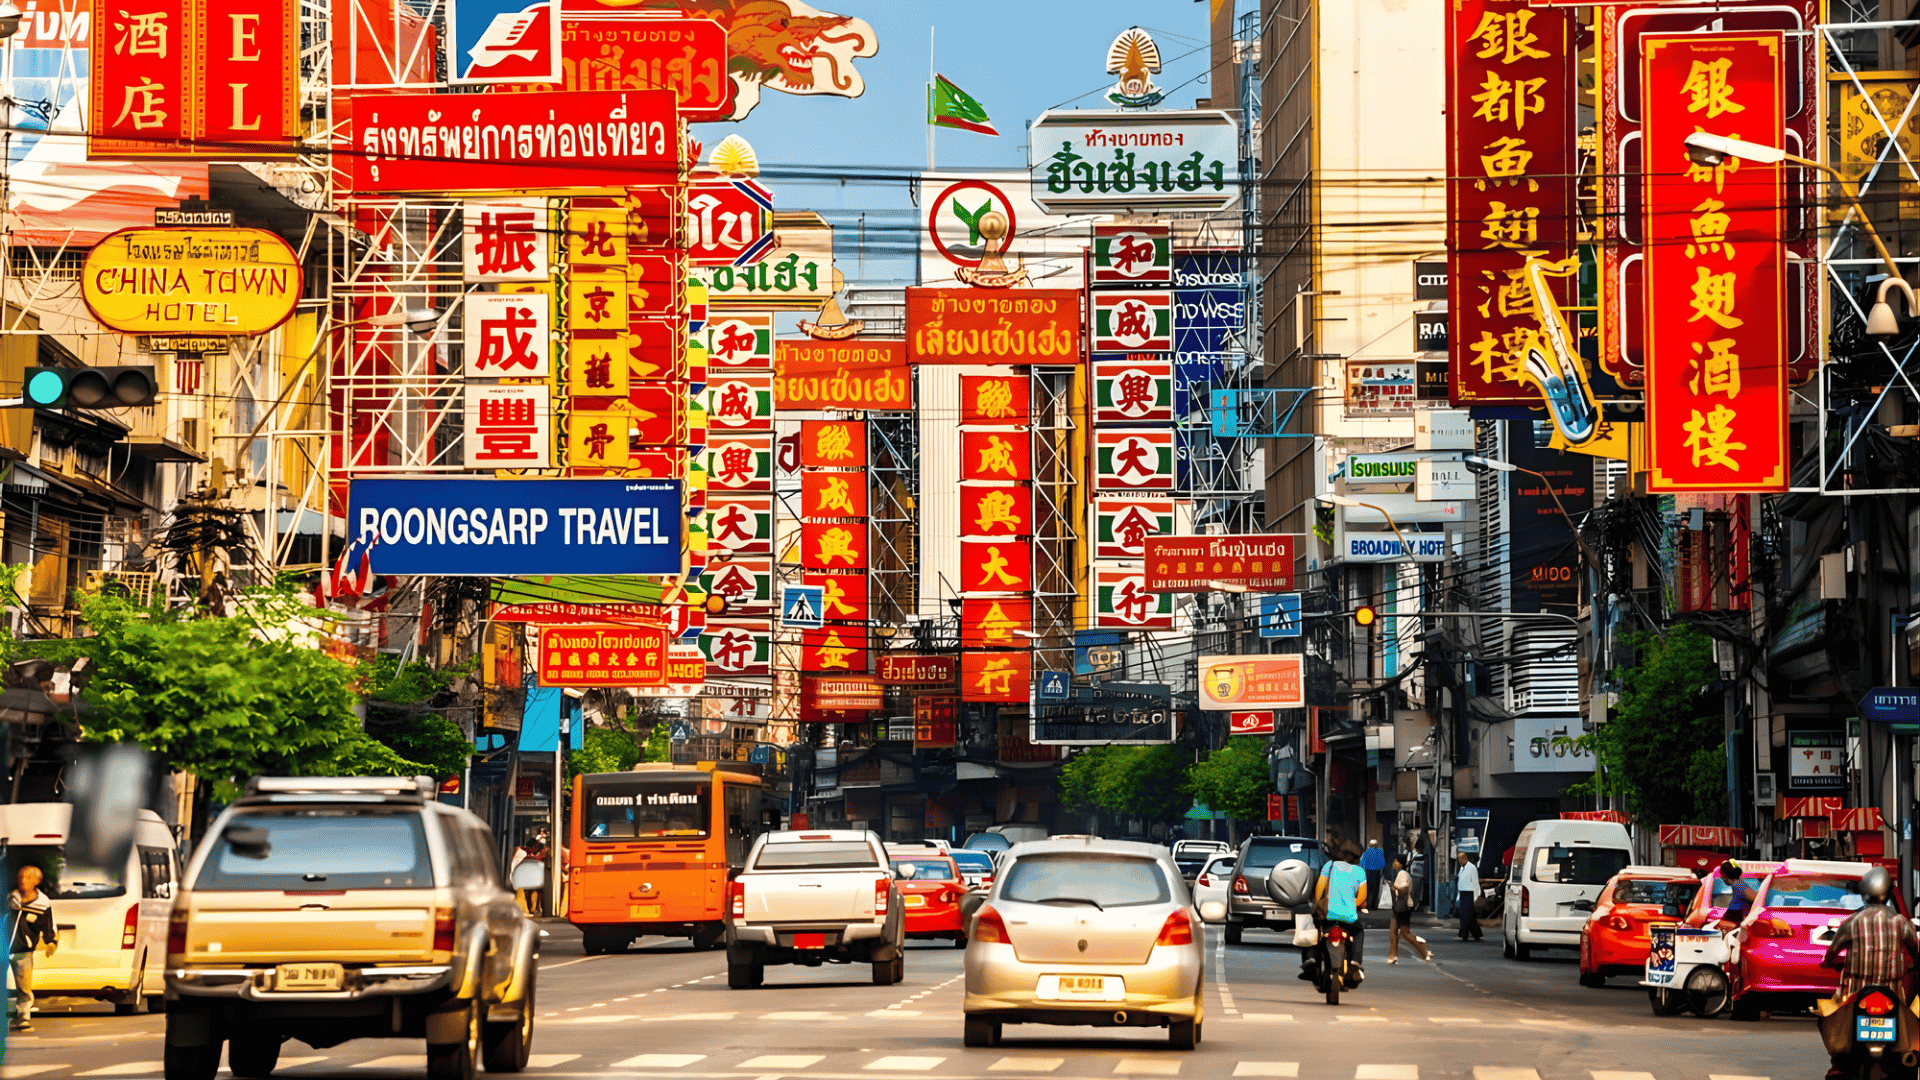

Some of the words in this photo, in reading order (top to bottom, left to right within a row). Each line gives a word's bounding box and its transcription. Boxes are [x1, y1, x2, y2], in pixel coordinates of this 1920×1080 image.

[112, 10, 168, 130] 酒店
[1084, 130, 1184, 147] ห้างขายทอง
[96, 267, 191, 295] CHINA
[203, 267, 287, 295] TOWN
[146, 302, 232, 323] HOTEL
[474, 210, 539, 461] 振成豐
[360, 507, 548, 545] ROONGSARP
[559, 507, 669, 545] TRAVEL
